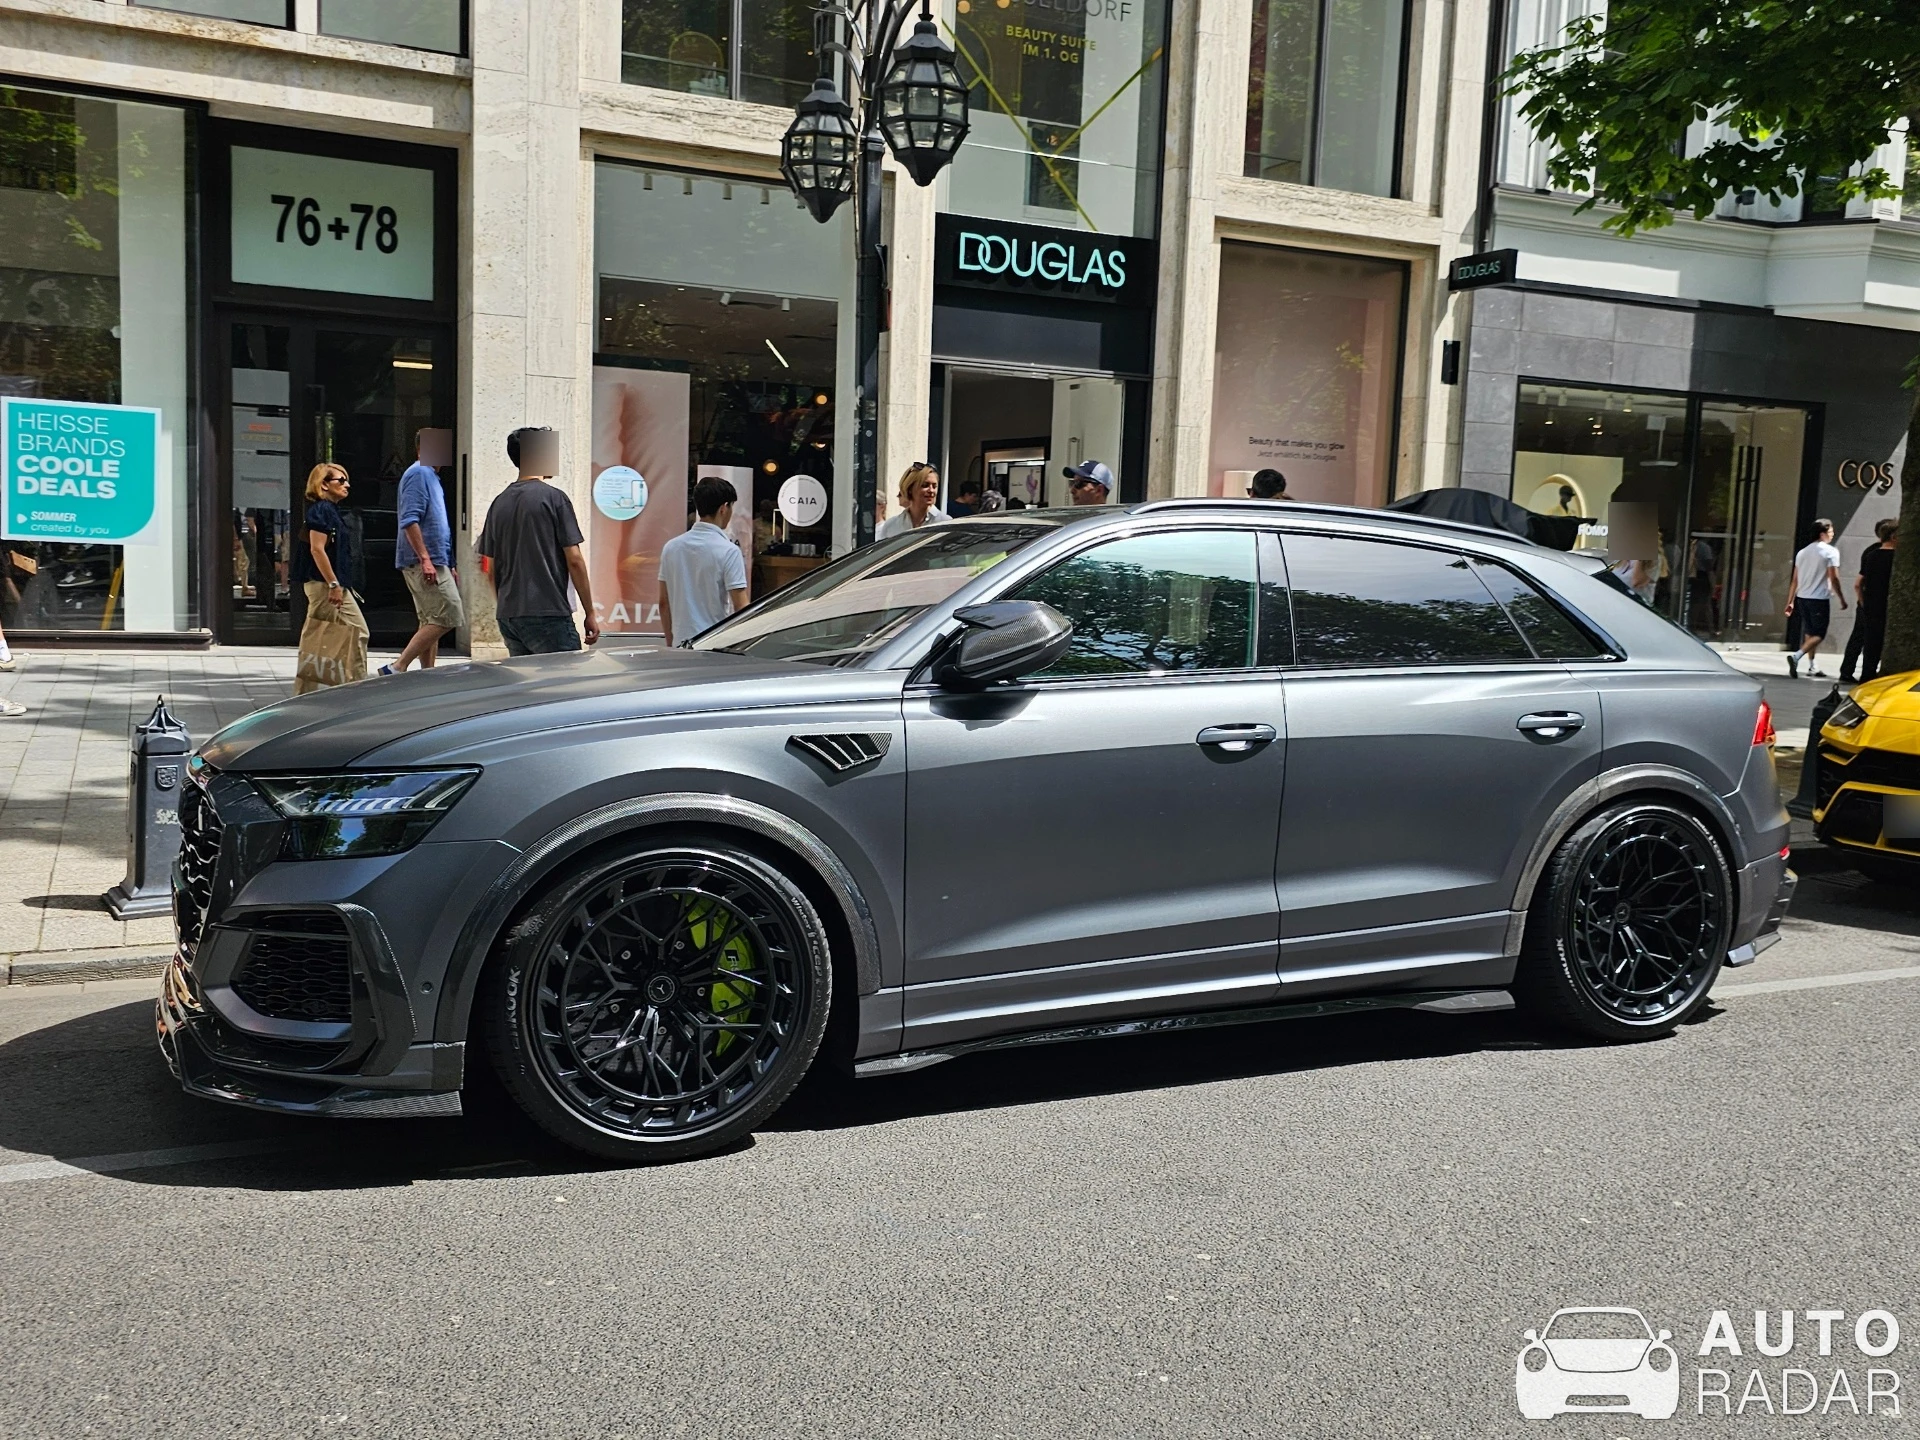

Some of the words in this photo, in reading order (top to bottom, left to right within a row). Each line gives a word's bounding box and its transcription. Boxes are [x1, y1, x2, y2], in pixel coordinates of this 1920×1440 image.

[1006, 24, 1057, 44] BEAUTY
[1060, 35, 1097, 51] SUITE
[1043, 48, 1056, 60] 1.
[1060, 51, 1079, 64] OG
[270, 194, 398, 254] 76+78
[959, 232, 1126, 288] DOUGLAS
[1458, 260, 1501, 280] DOUGLAS
[17, 412, 109, 435] HEISSE
[17, 433, 126, 457] BRANDS
[1248, 436, 1273, 447] Beauty
[1275, 439, 1289, 447] that
[1290, 440, 1313, 449] makes
[1313, 442, 1327, 450] you
[1328, 442, 1345, 451] glow
[17, 454, 121, 478] COOLE
[1838, 459, 1894, 489] COS
[17, 475, 117, 499] DEALS
[788, 496, 817, 506] CAIA
[30, 511, 77, 523] SOMMER
[30, 523, 71, 533] created
[74, 524, 87, 535] by
[89, 527, 110, 535] you
